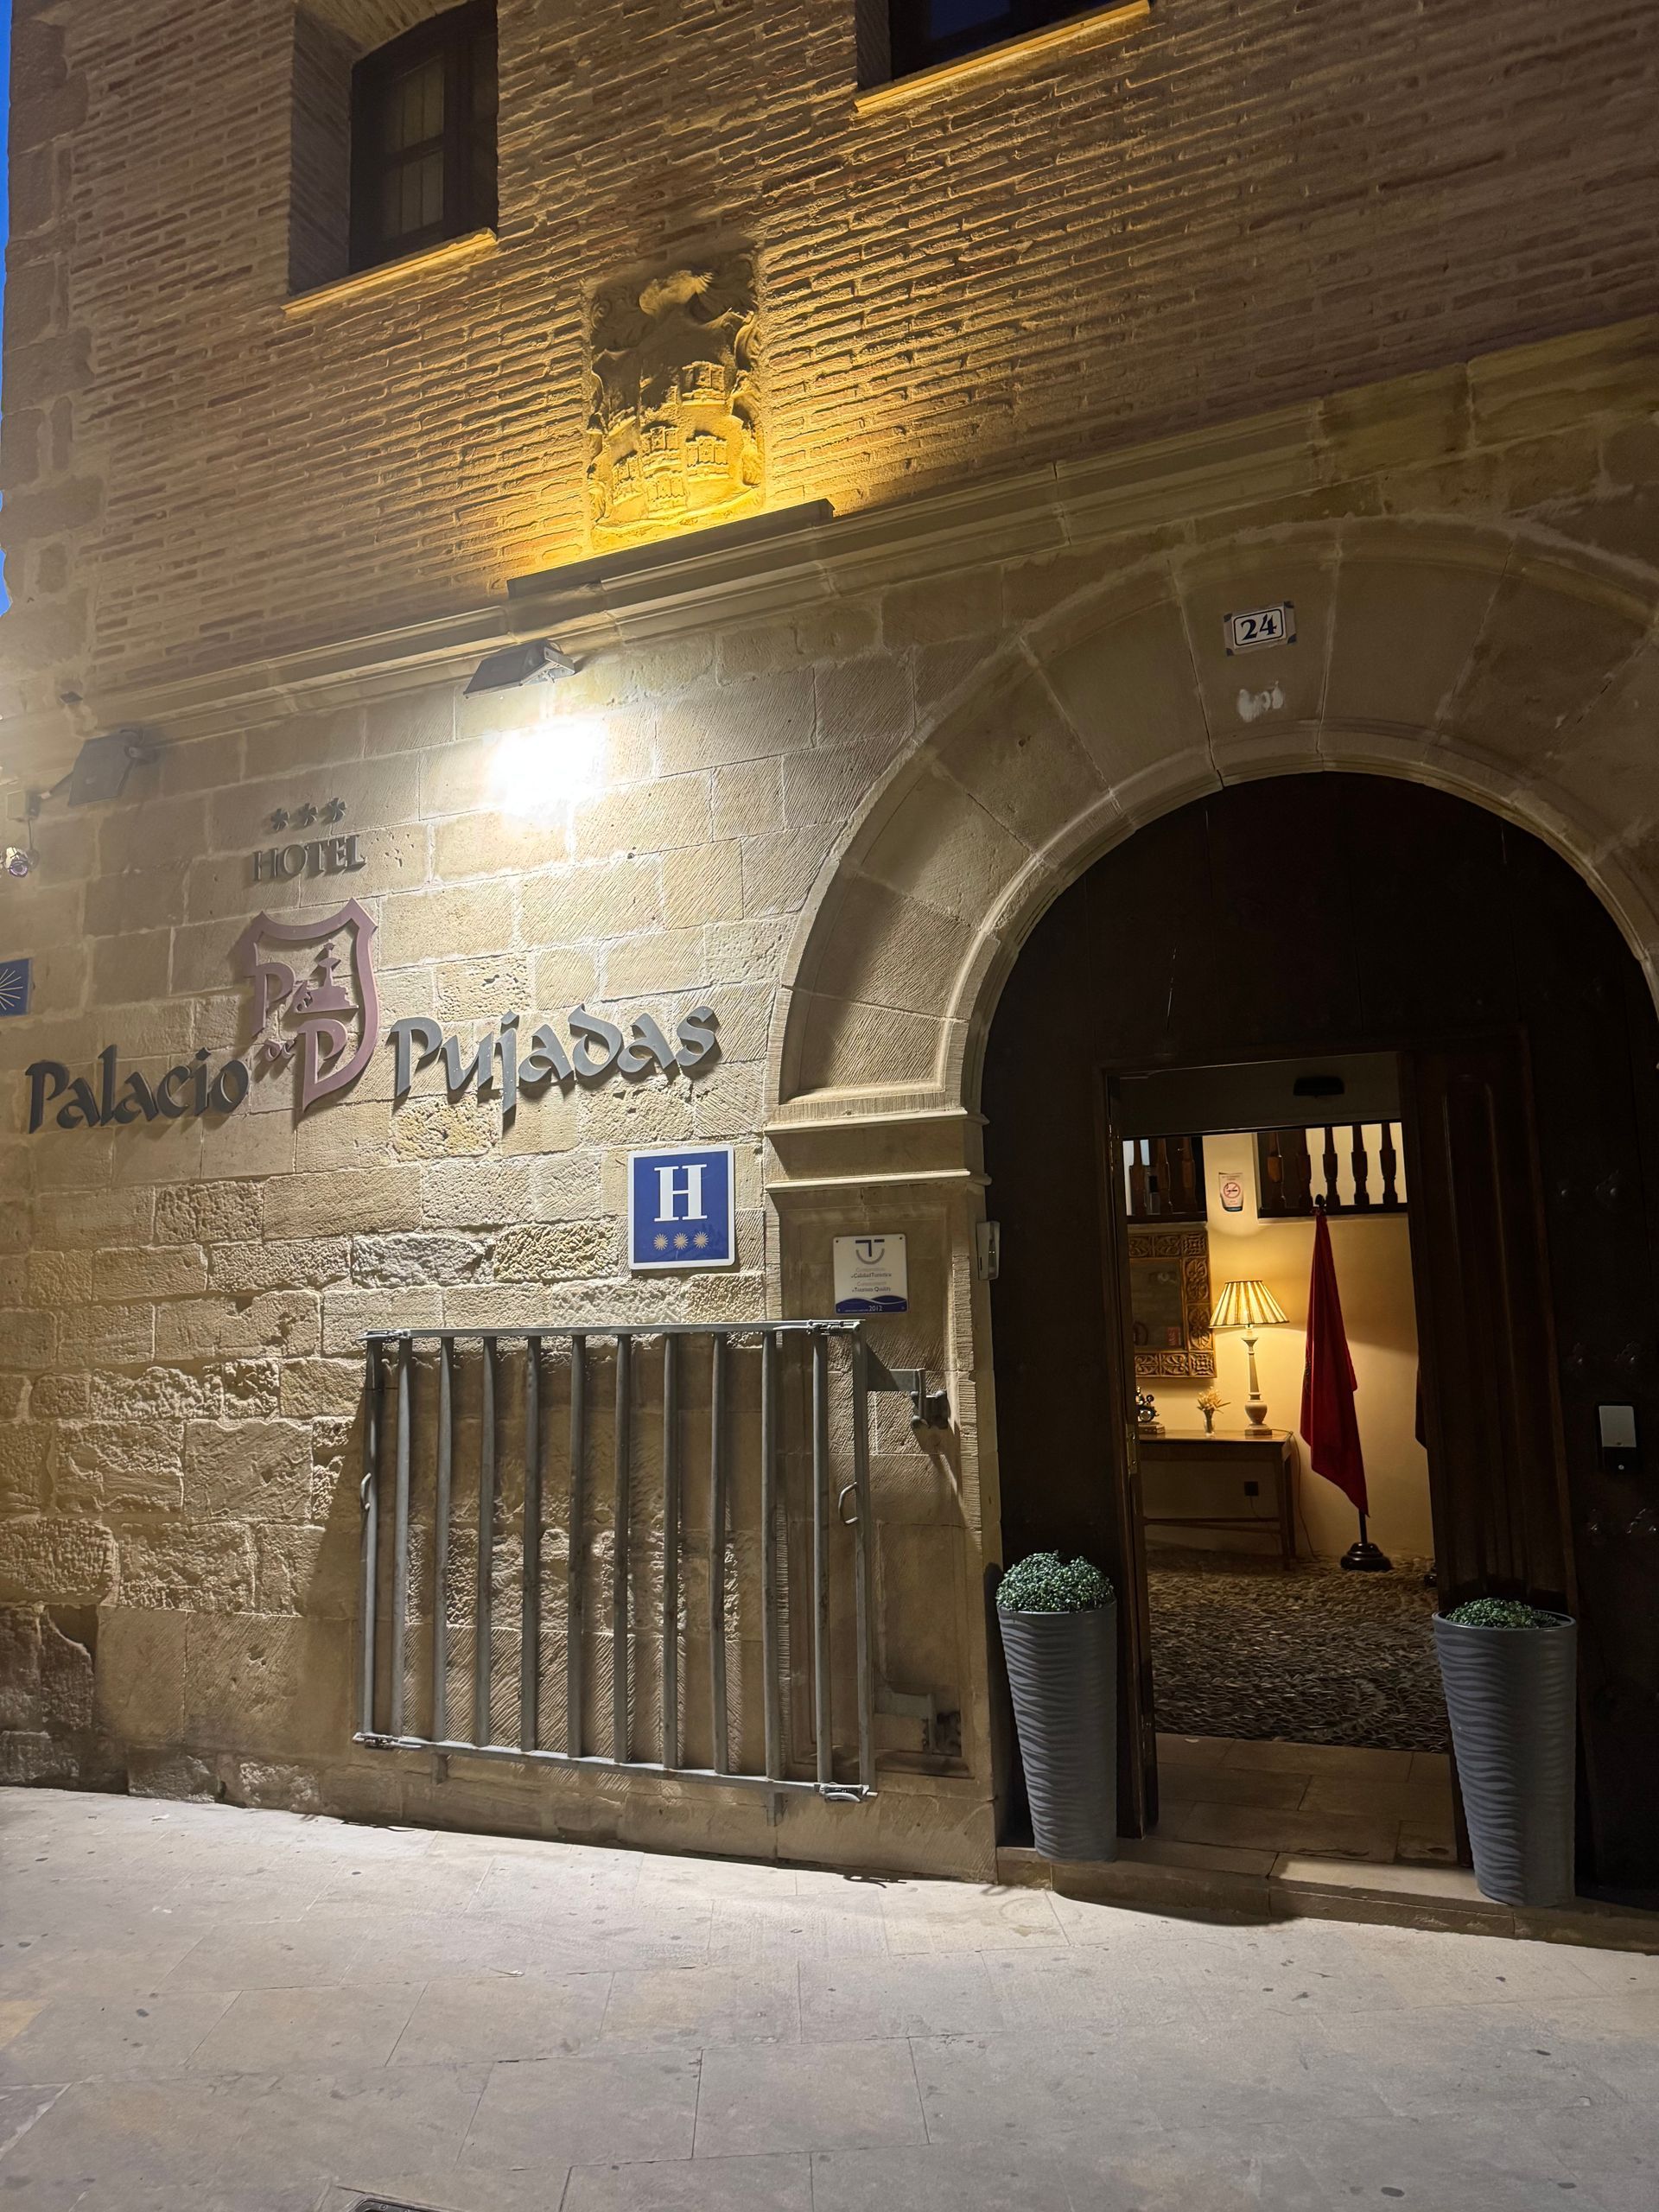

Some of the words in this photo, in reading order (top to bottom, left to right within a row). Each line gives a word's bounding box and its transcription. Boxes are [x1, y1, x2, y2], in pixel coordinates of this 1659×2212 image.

[1242, 614, 1277, 640] 24
[253, 835, 367, 881] HOTEL
[25, 1045, 250, 1133] Palacio
[264, 1039, 296, 1063] de
[391, 1004, 718, 1115] Pujadas
[654, 1164, 707, 1222] H
